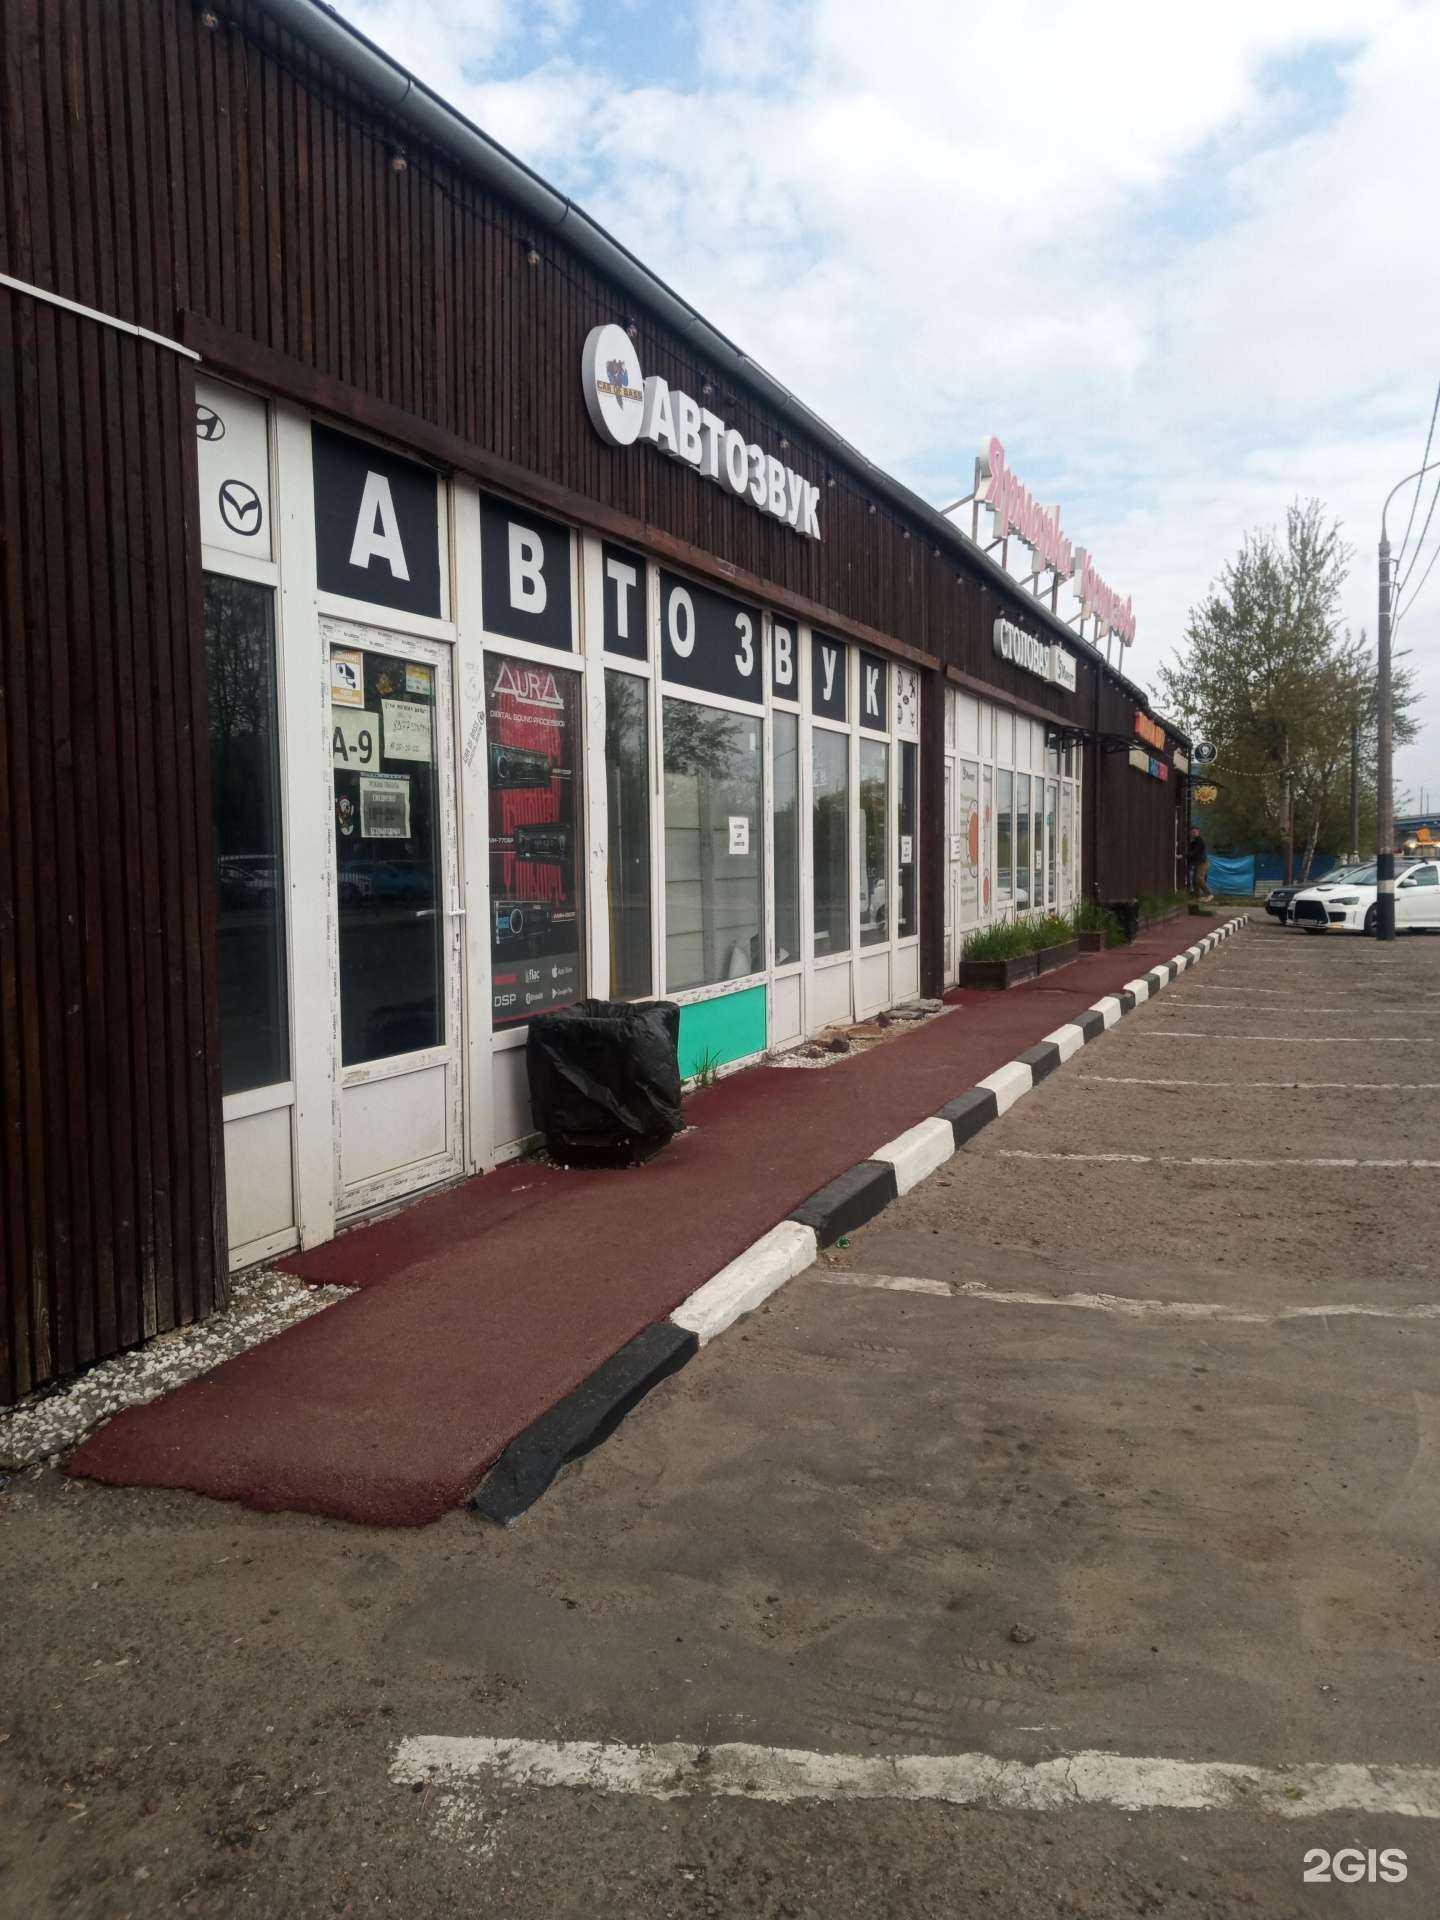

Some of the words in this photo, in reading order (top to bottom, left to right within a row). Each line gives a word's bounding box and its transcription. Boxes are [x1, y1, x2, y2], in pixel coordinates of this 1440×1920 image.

[642, 375, 822, 541] АВТОЗВУК
[996, 618, 1050, 680] СТОЛОВАЯ
[493, 661, 565, 709] AURA
[494, 993, 517, 1008] DSP
